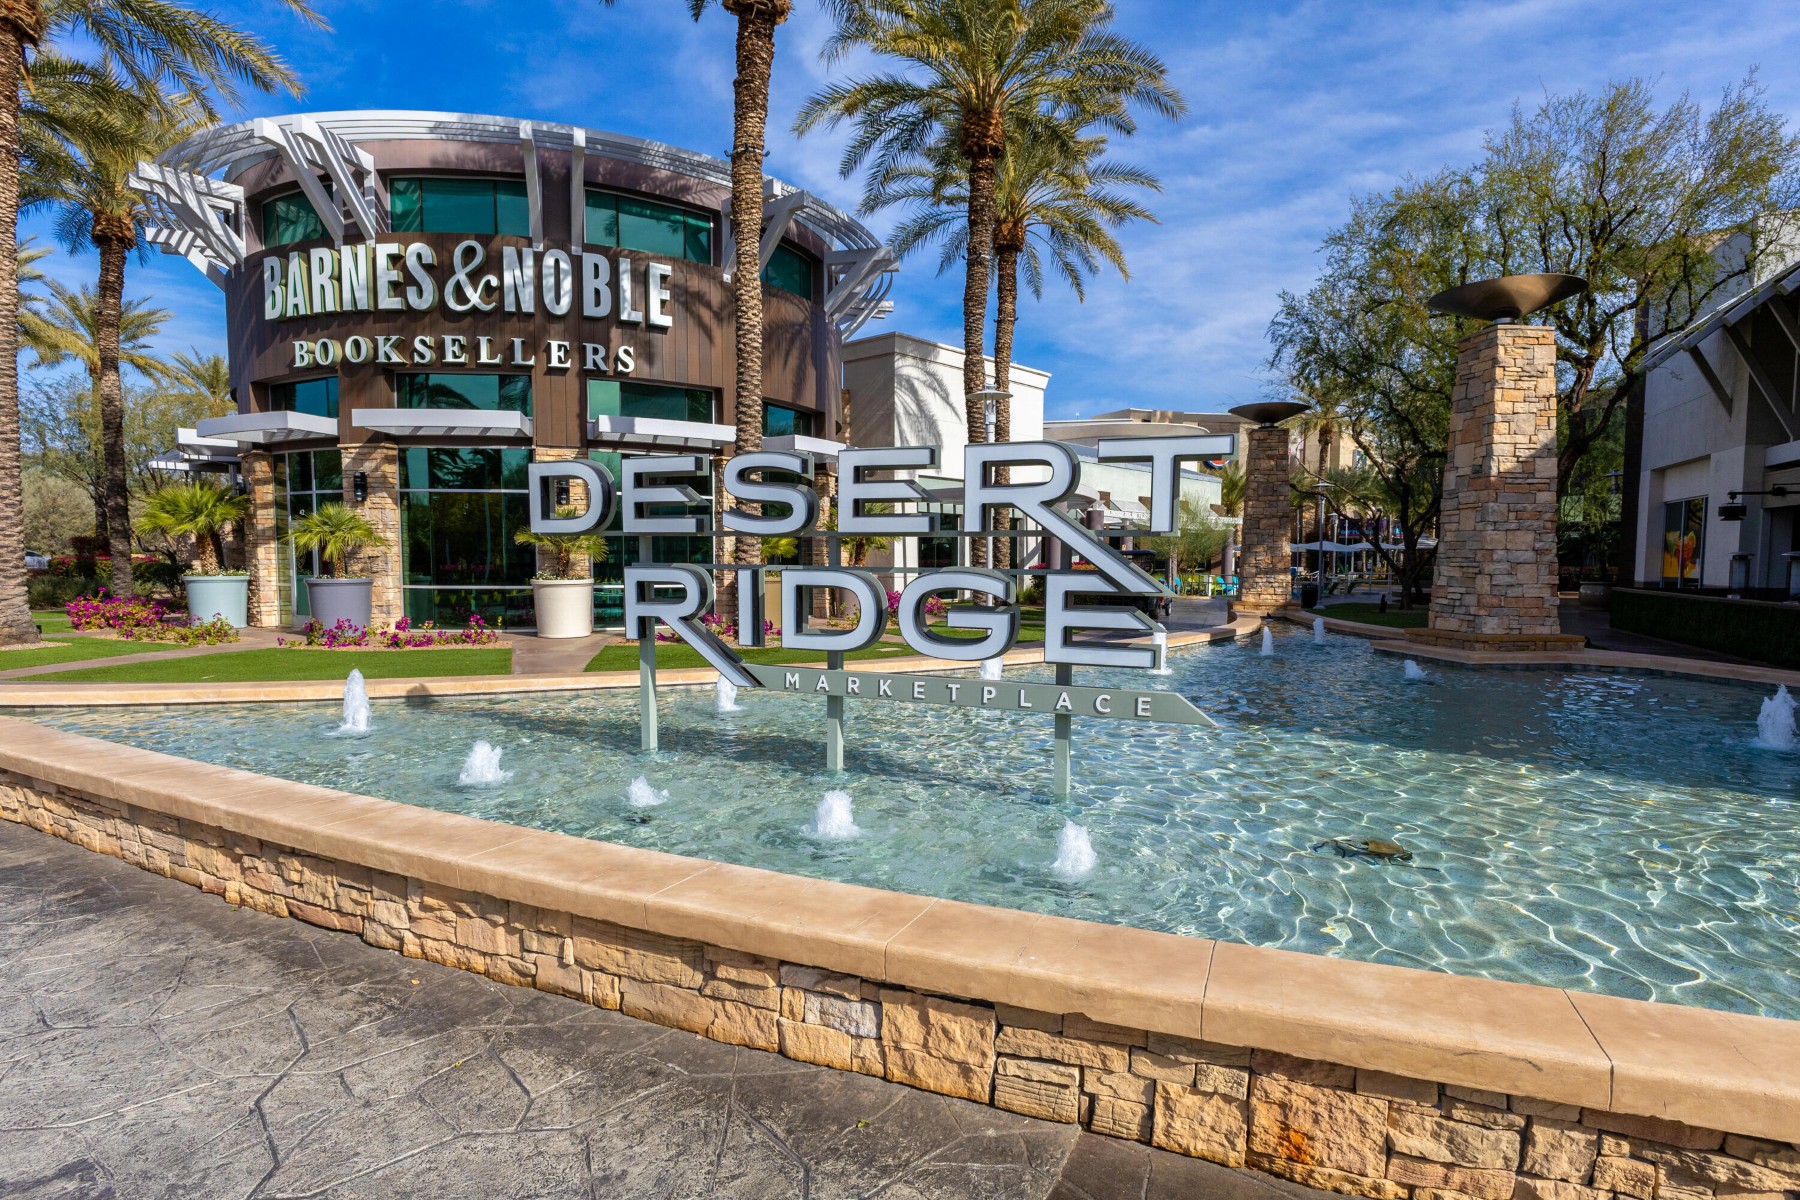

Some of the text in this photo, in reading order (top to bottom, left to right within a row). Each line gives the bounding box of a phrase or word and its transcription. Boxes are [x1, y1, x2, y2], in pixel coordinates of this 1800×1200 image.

[263, 239, 673, 329] BARNES & NOBLE
[292, 334, 636, 374] BOOKSELLERS
[528, 433, 1240, 598] DESERT
[624, 562, 1168, 689] RIDGE
[784, 672, 1152, 718] MARKETPLACE
